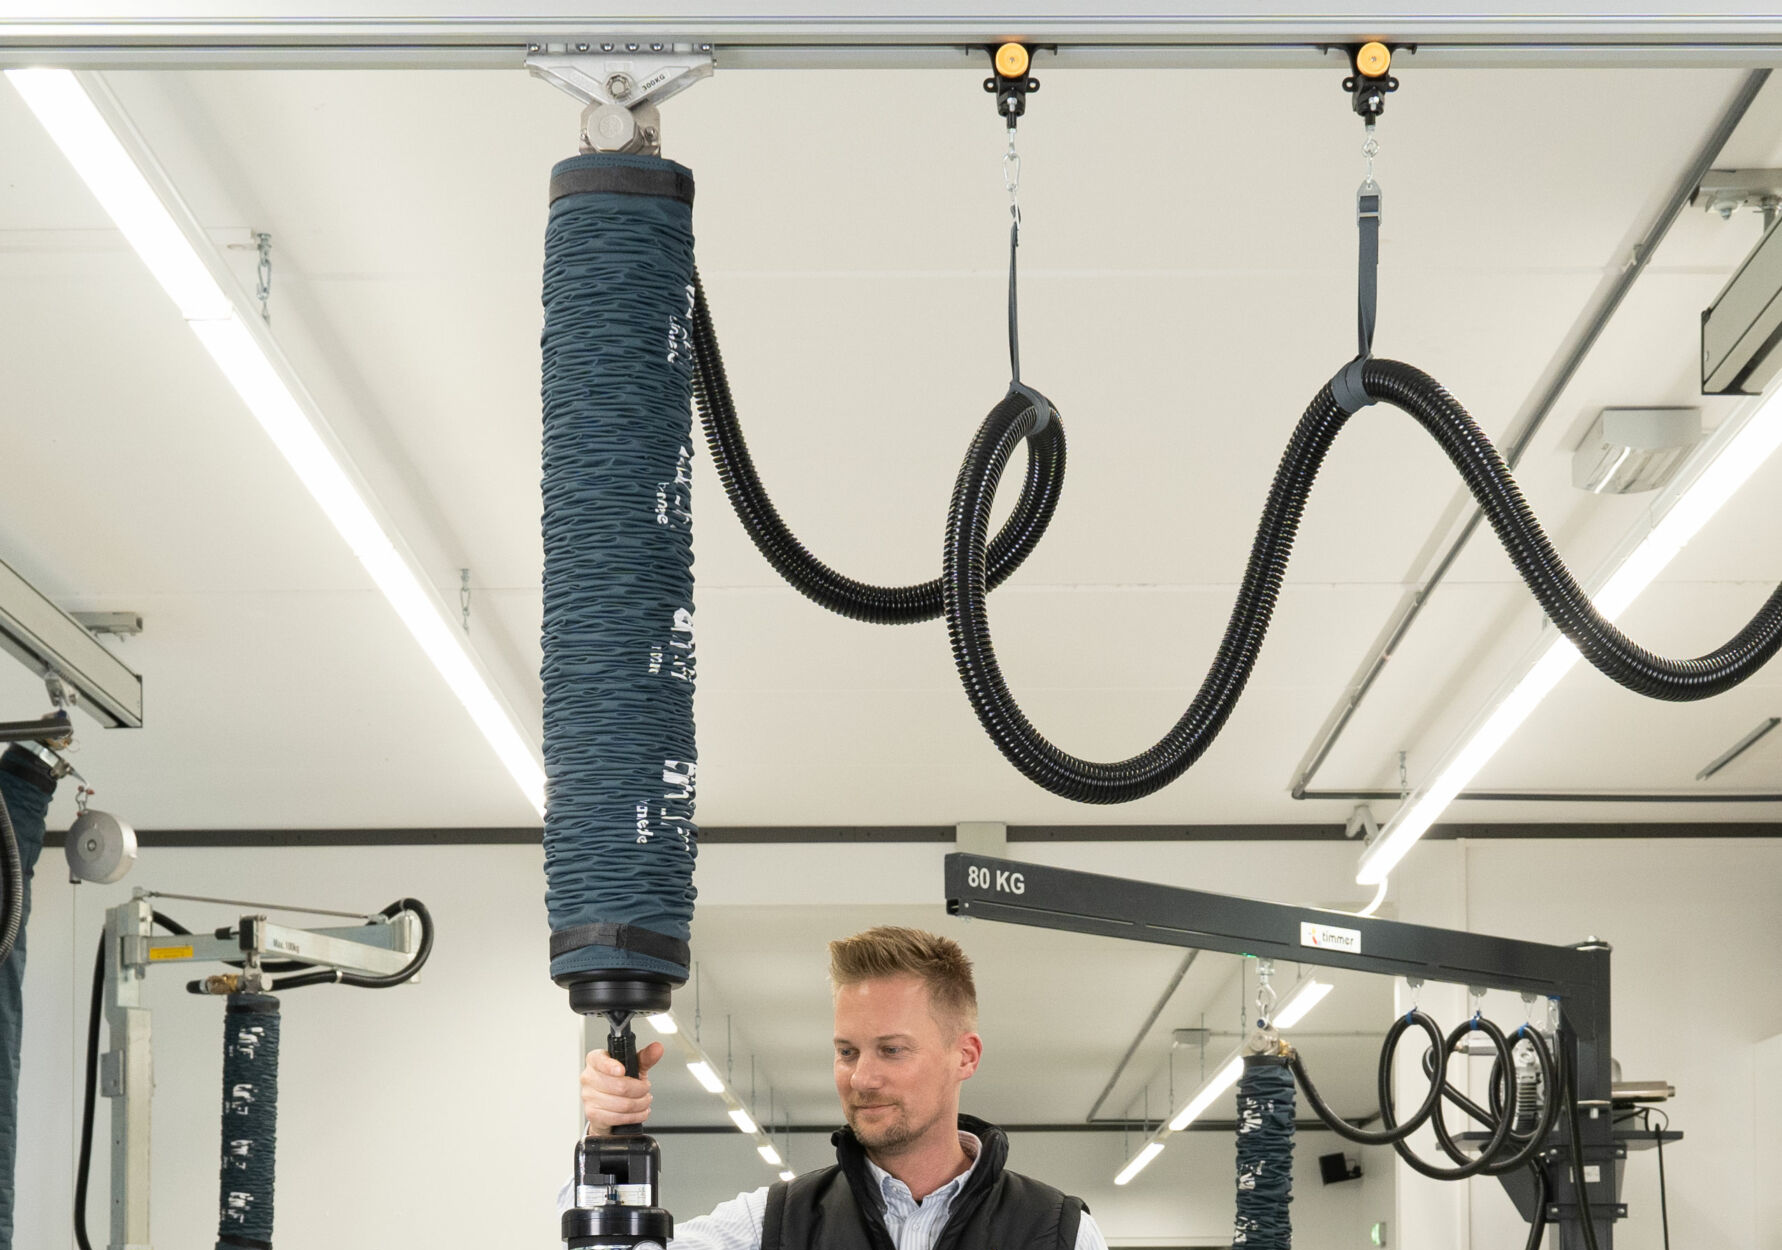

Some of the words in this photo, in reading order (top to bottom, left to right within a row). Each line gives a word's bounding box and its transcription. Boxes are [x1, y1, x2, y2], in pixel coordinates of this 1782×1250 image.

[641, 74, 666, 91] 300KG
[968, 865, 990, 889] 80
[996, 870, 1025, 895] KG
[1322, 931, 1354, 945] timmer
